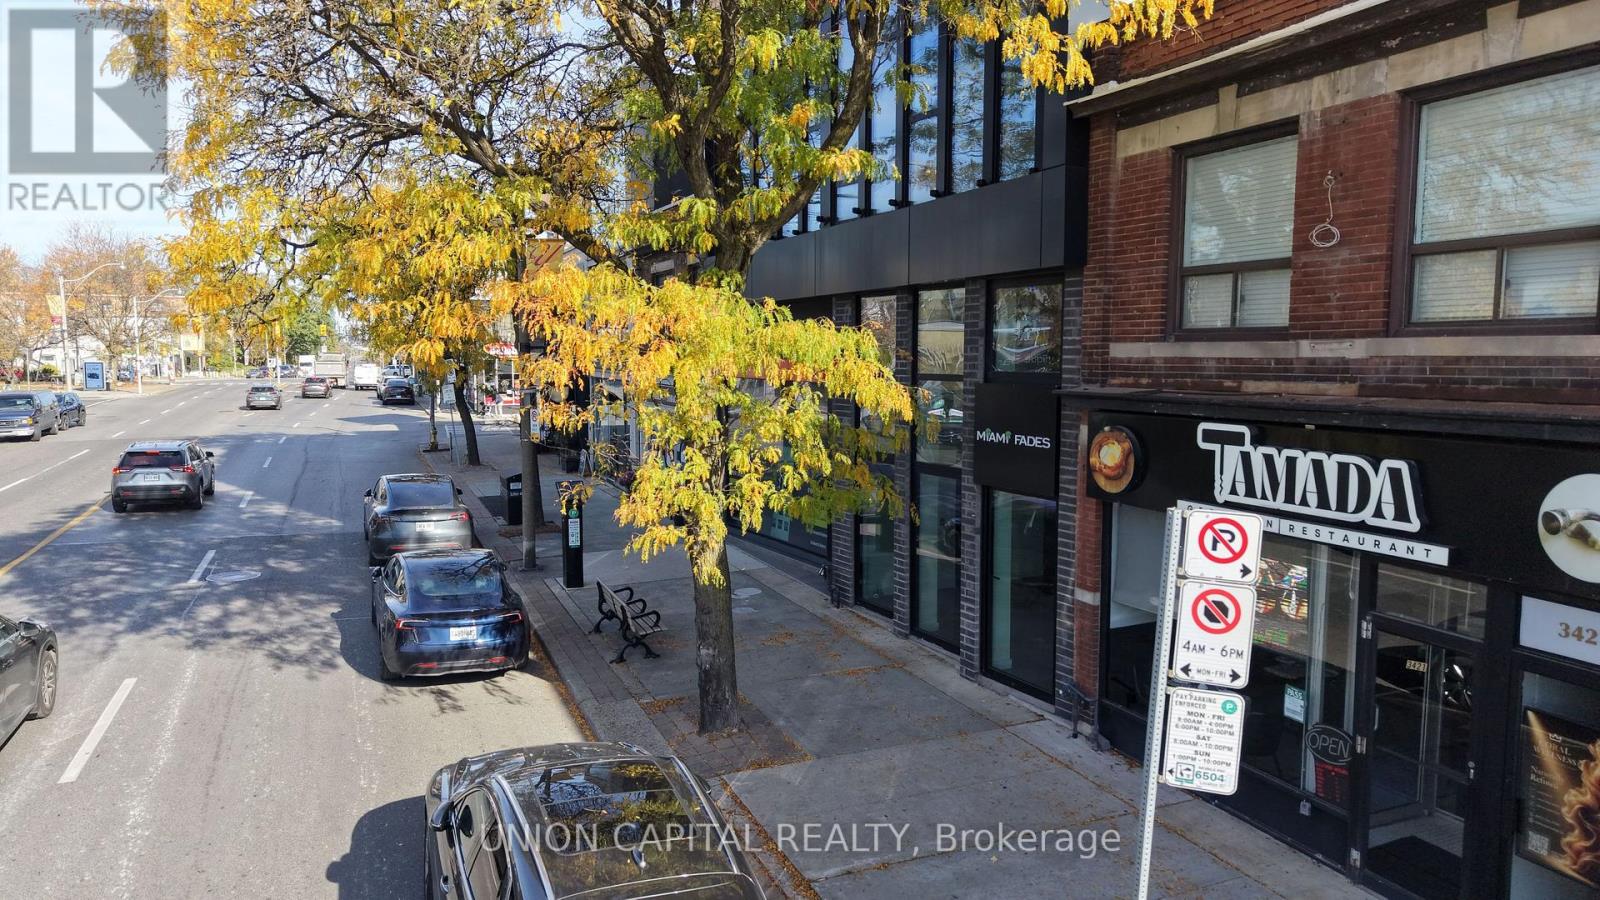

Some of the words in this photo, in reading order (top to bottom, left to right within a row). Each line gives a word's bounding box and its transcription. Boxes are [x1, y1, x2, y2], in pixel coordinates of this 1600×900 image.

[976, 428, 1012, 444] MIAMI
[1014, 434, 1051, 449] FADES
[1197, 421, 1421, 533] TAMADA
[1289, 524, 1433, 559] RESTAURANT
[1558, 622, 1598, 646] 342
[1182, 640, 1206, 655] 4AM
[1220, 645, 1244, 660] 6PM
[1287, 688, 1304, 700] PASS
[1196, 734, 1211, 742] SAT
[1308, 732, 1350, 759] OPEN
[1194, 749, 1211, 758] SUN
[1195, 770, 1225, 782] 6504
